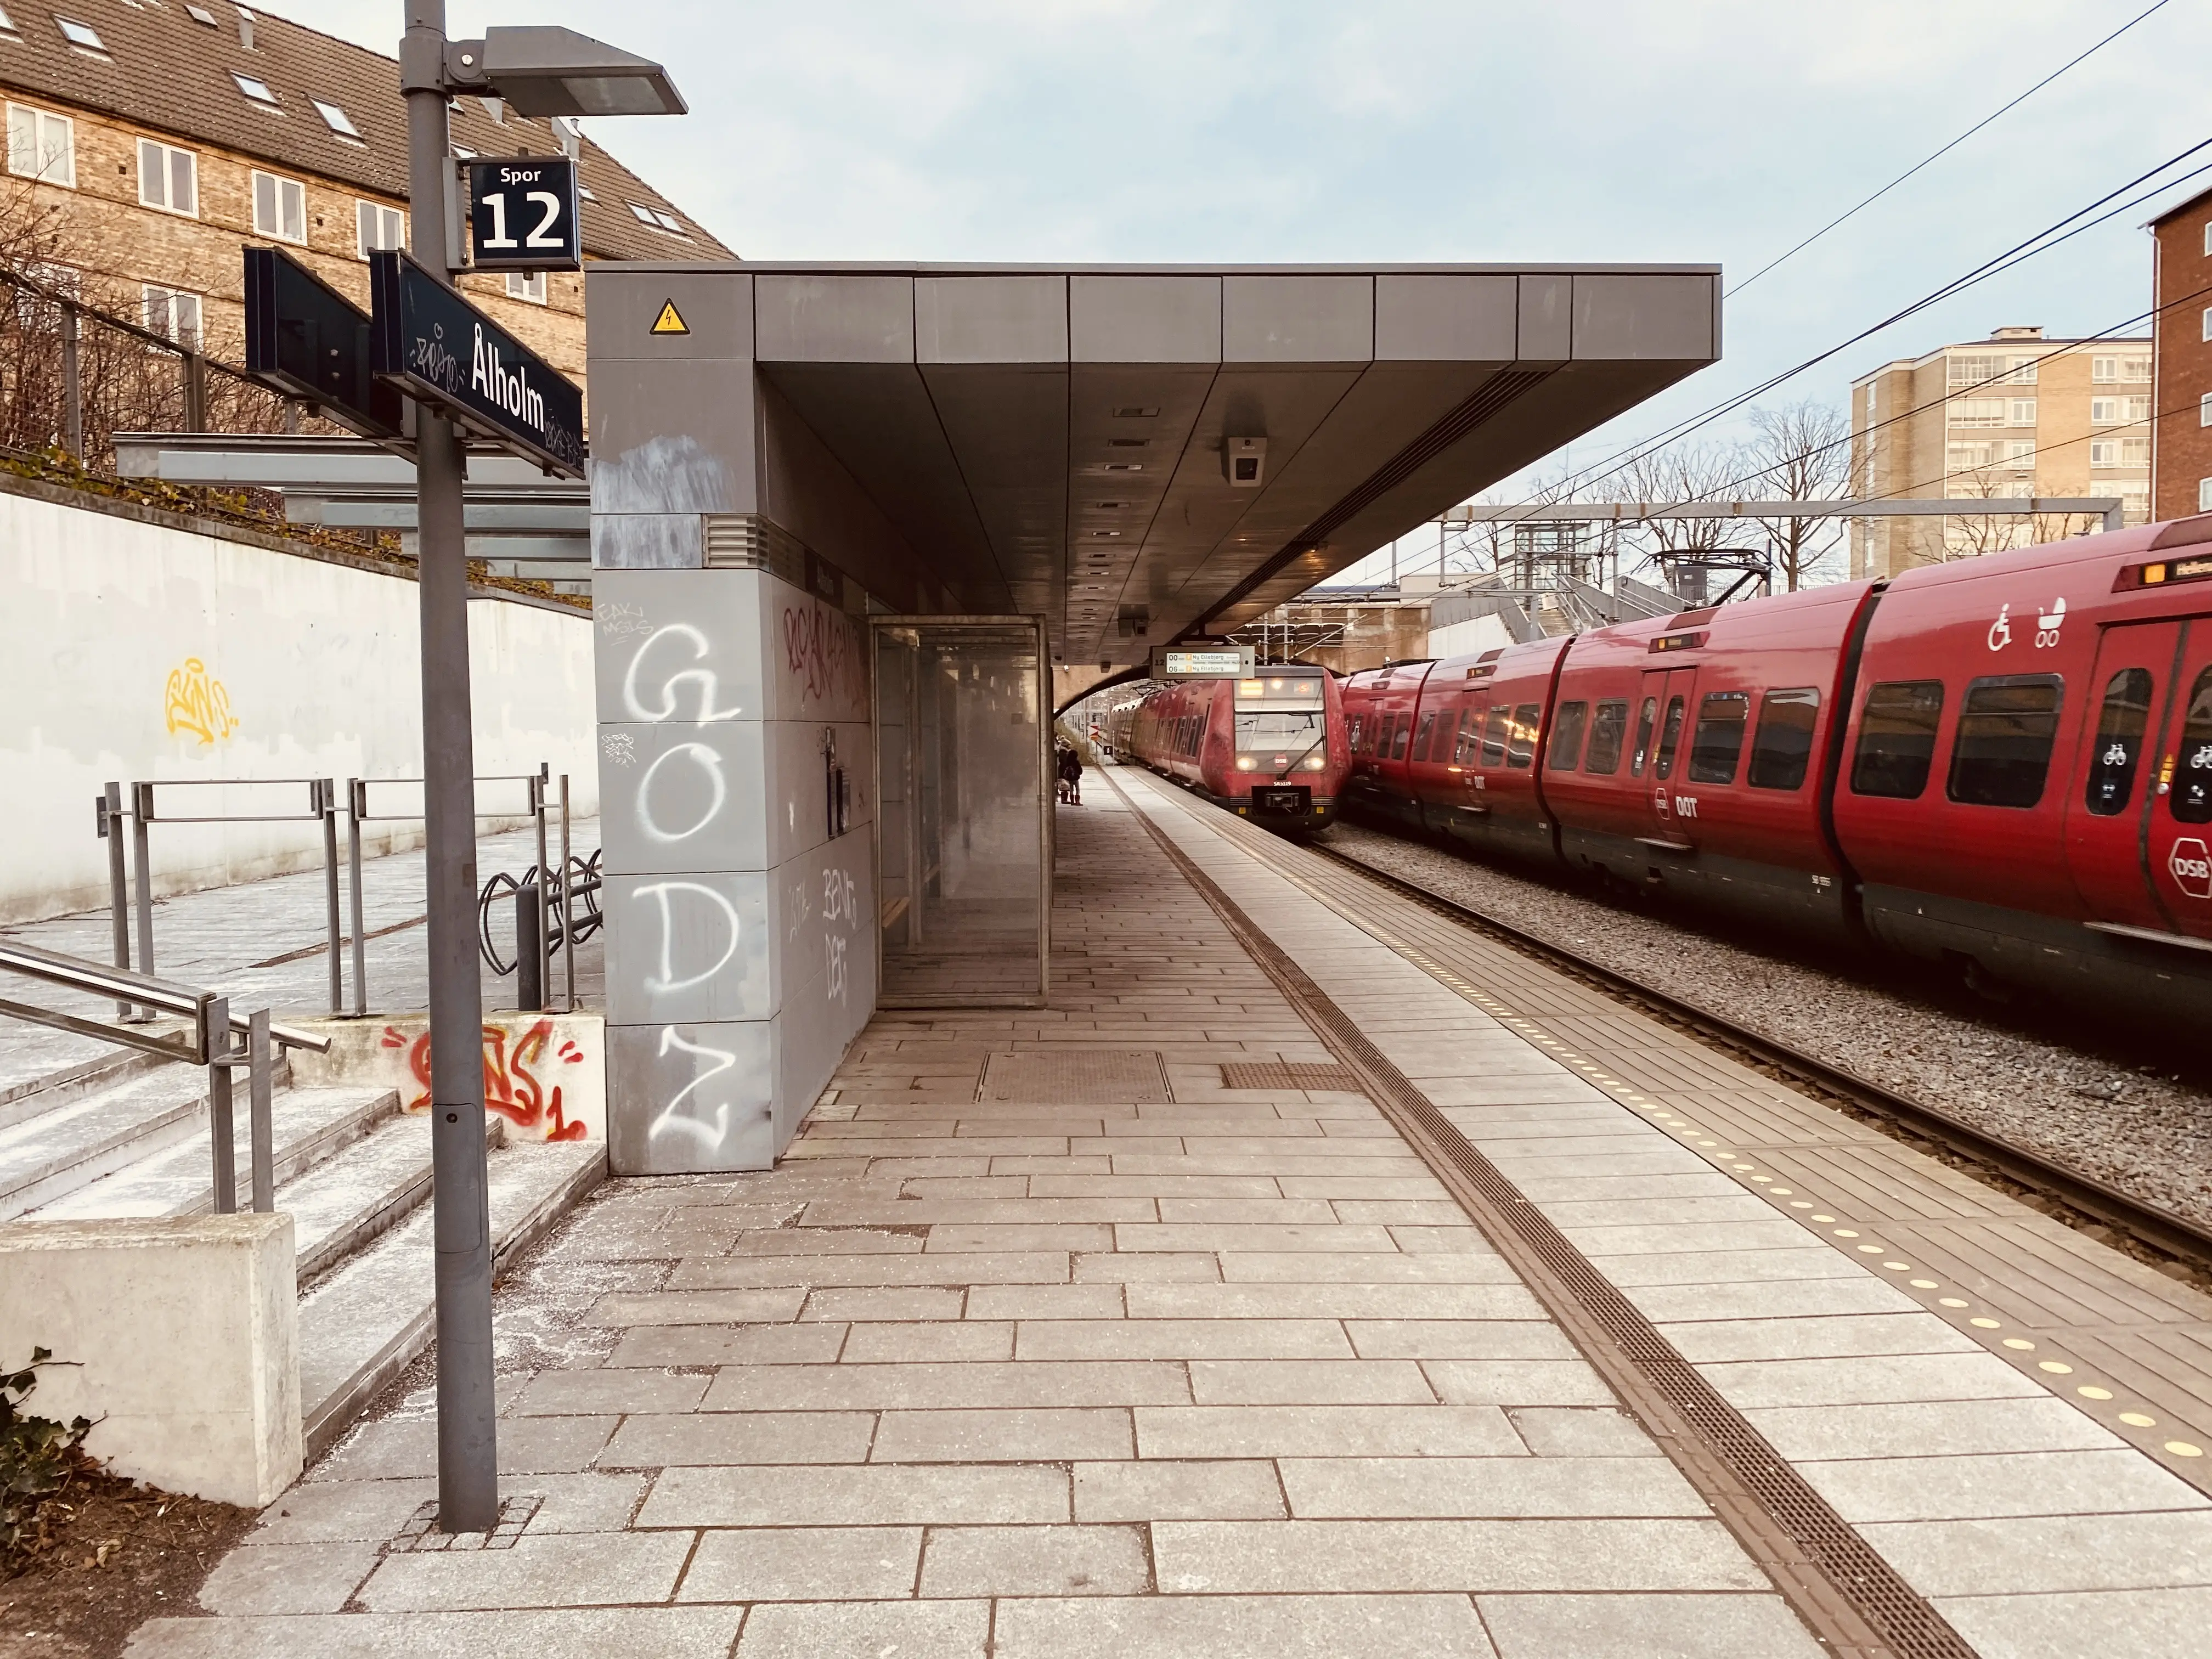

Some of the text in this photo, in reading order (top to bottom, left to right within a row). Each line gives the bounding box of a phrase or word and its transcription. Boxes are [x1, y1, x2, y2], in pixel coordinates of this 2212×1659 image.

[500, 167, 541, 185] Spor
[482, 191, 563, 248] 12
[472, 322, 544, 433] Ålholm
[1675, 796, 1698, 818] DOT
[2175, 857, 2208, 878] DSB
